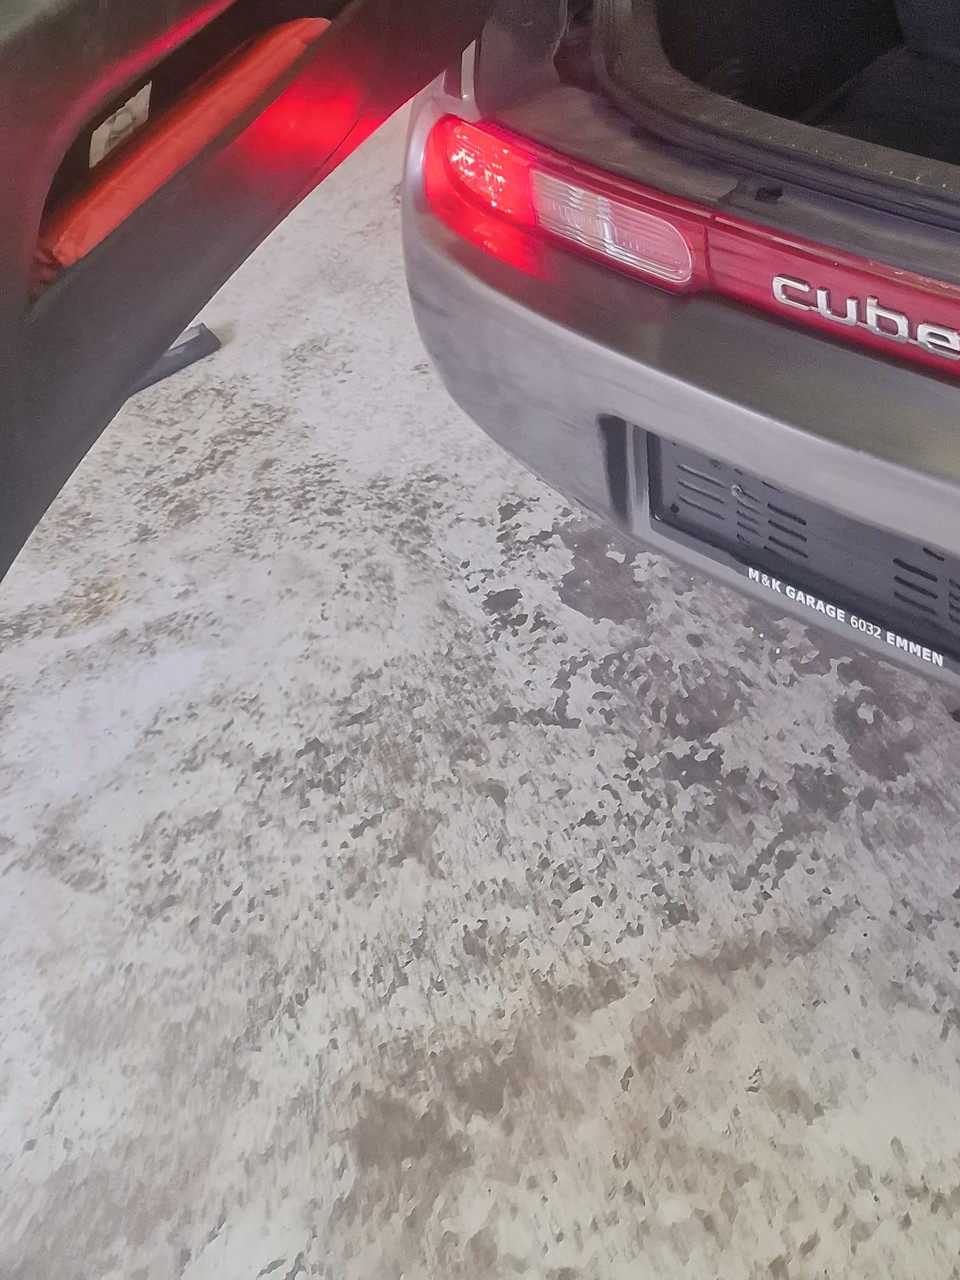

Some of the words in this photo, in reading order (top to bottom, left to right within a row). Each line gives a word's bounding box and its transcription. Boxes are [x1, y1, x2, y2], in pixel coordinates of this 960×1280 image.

[748, 567, 781, 593] M&K
[785, 585, 845, 622] GARAGE
[849, 615, 882, 639] 6032
[886, 630, 944, 667] EMMEN
